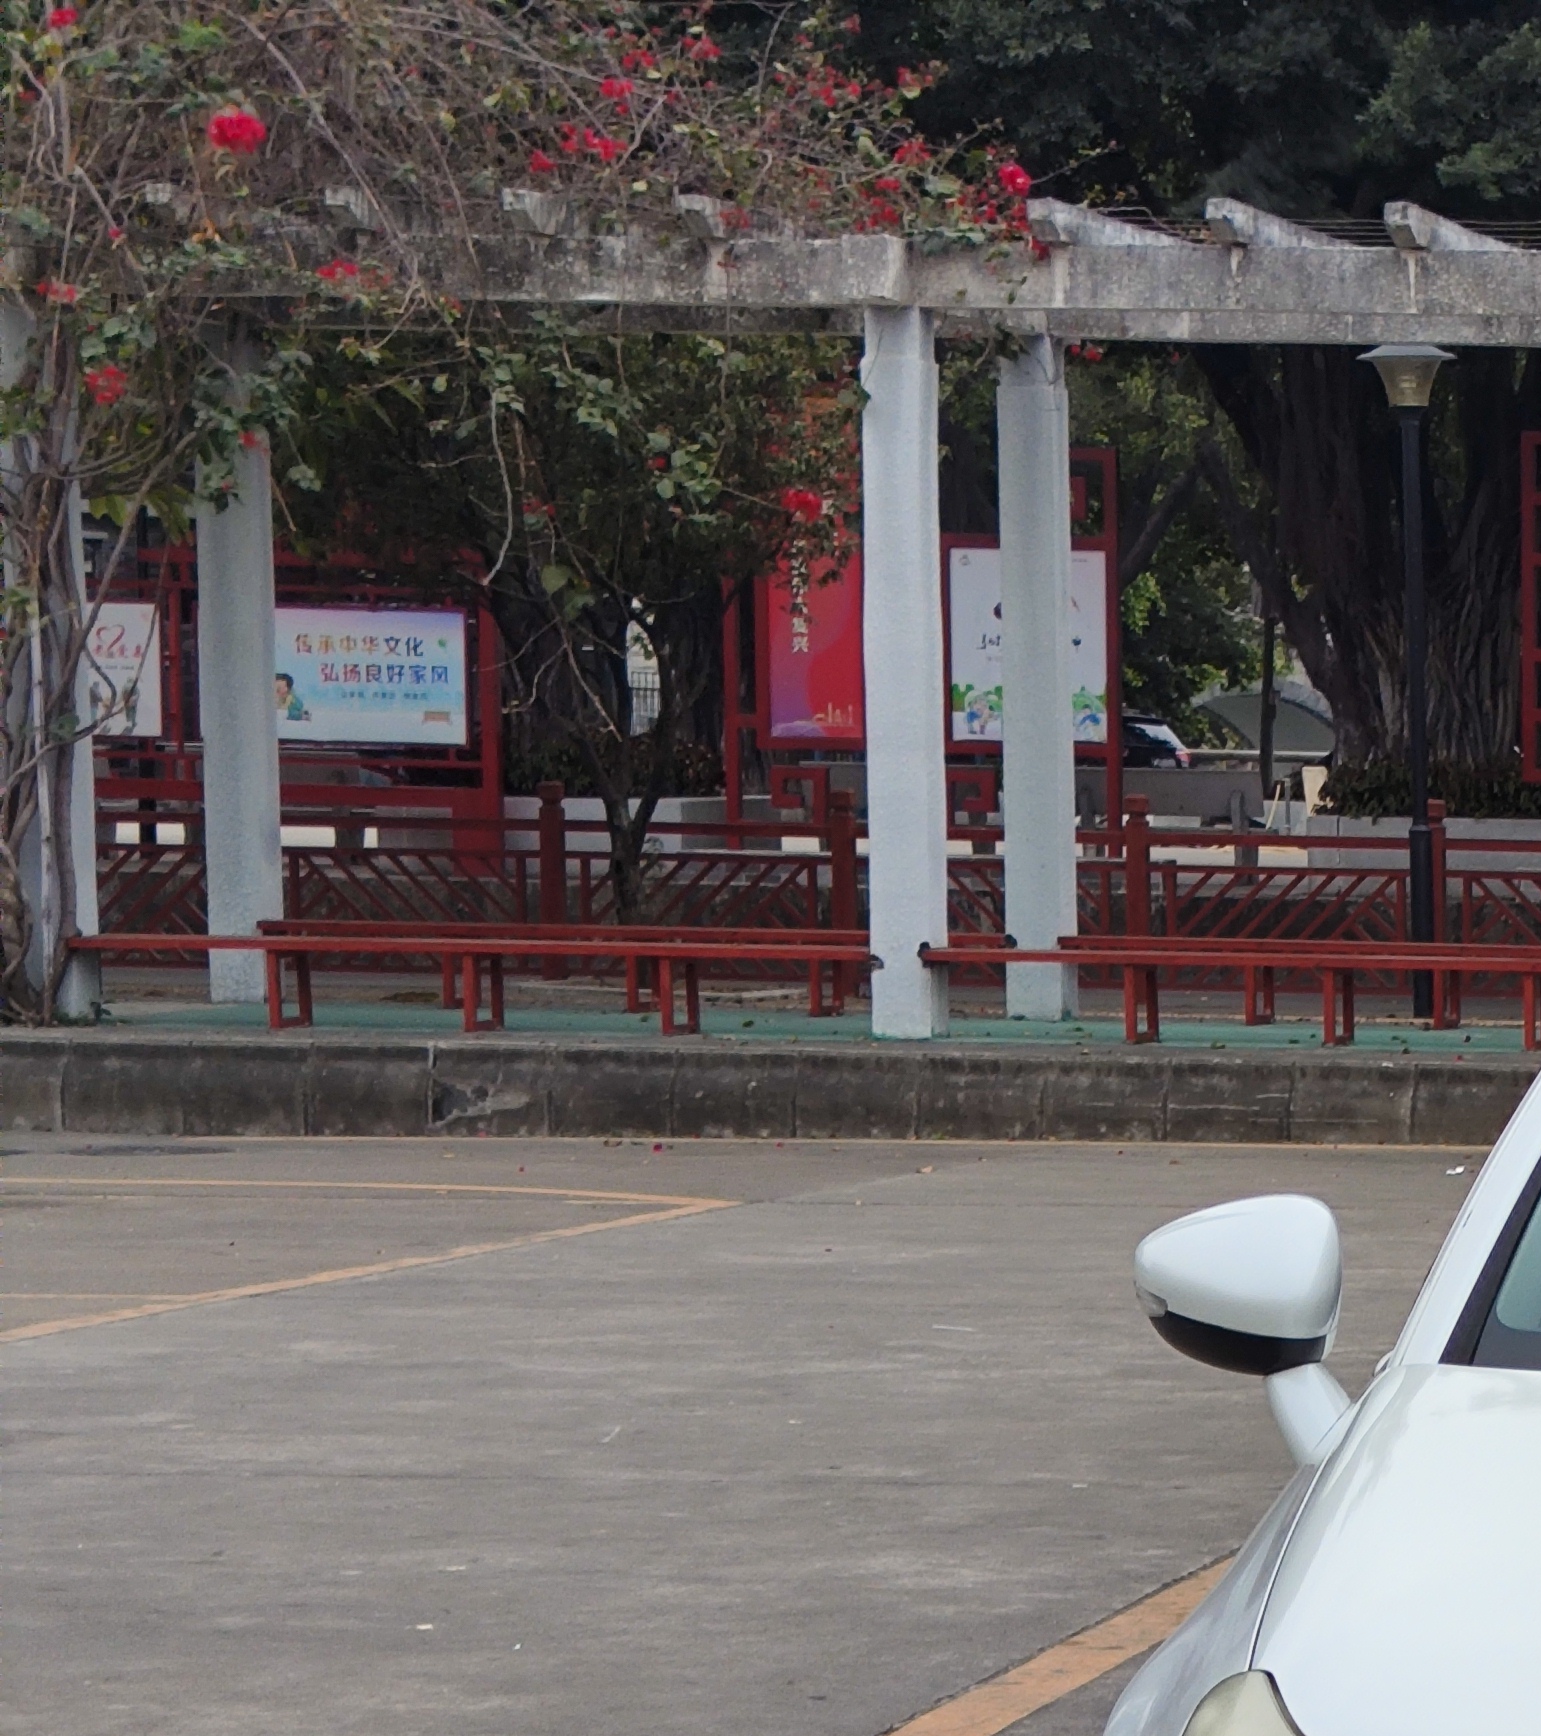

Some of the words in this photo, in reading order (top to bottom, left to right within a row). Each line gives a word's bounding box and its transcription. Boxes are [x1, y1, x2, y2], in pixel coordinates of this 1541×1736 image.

[295, 633, 424, 657] 传承中华文化
[320, 663, 449, 684] 弘扬良好家风
